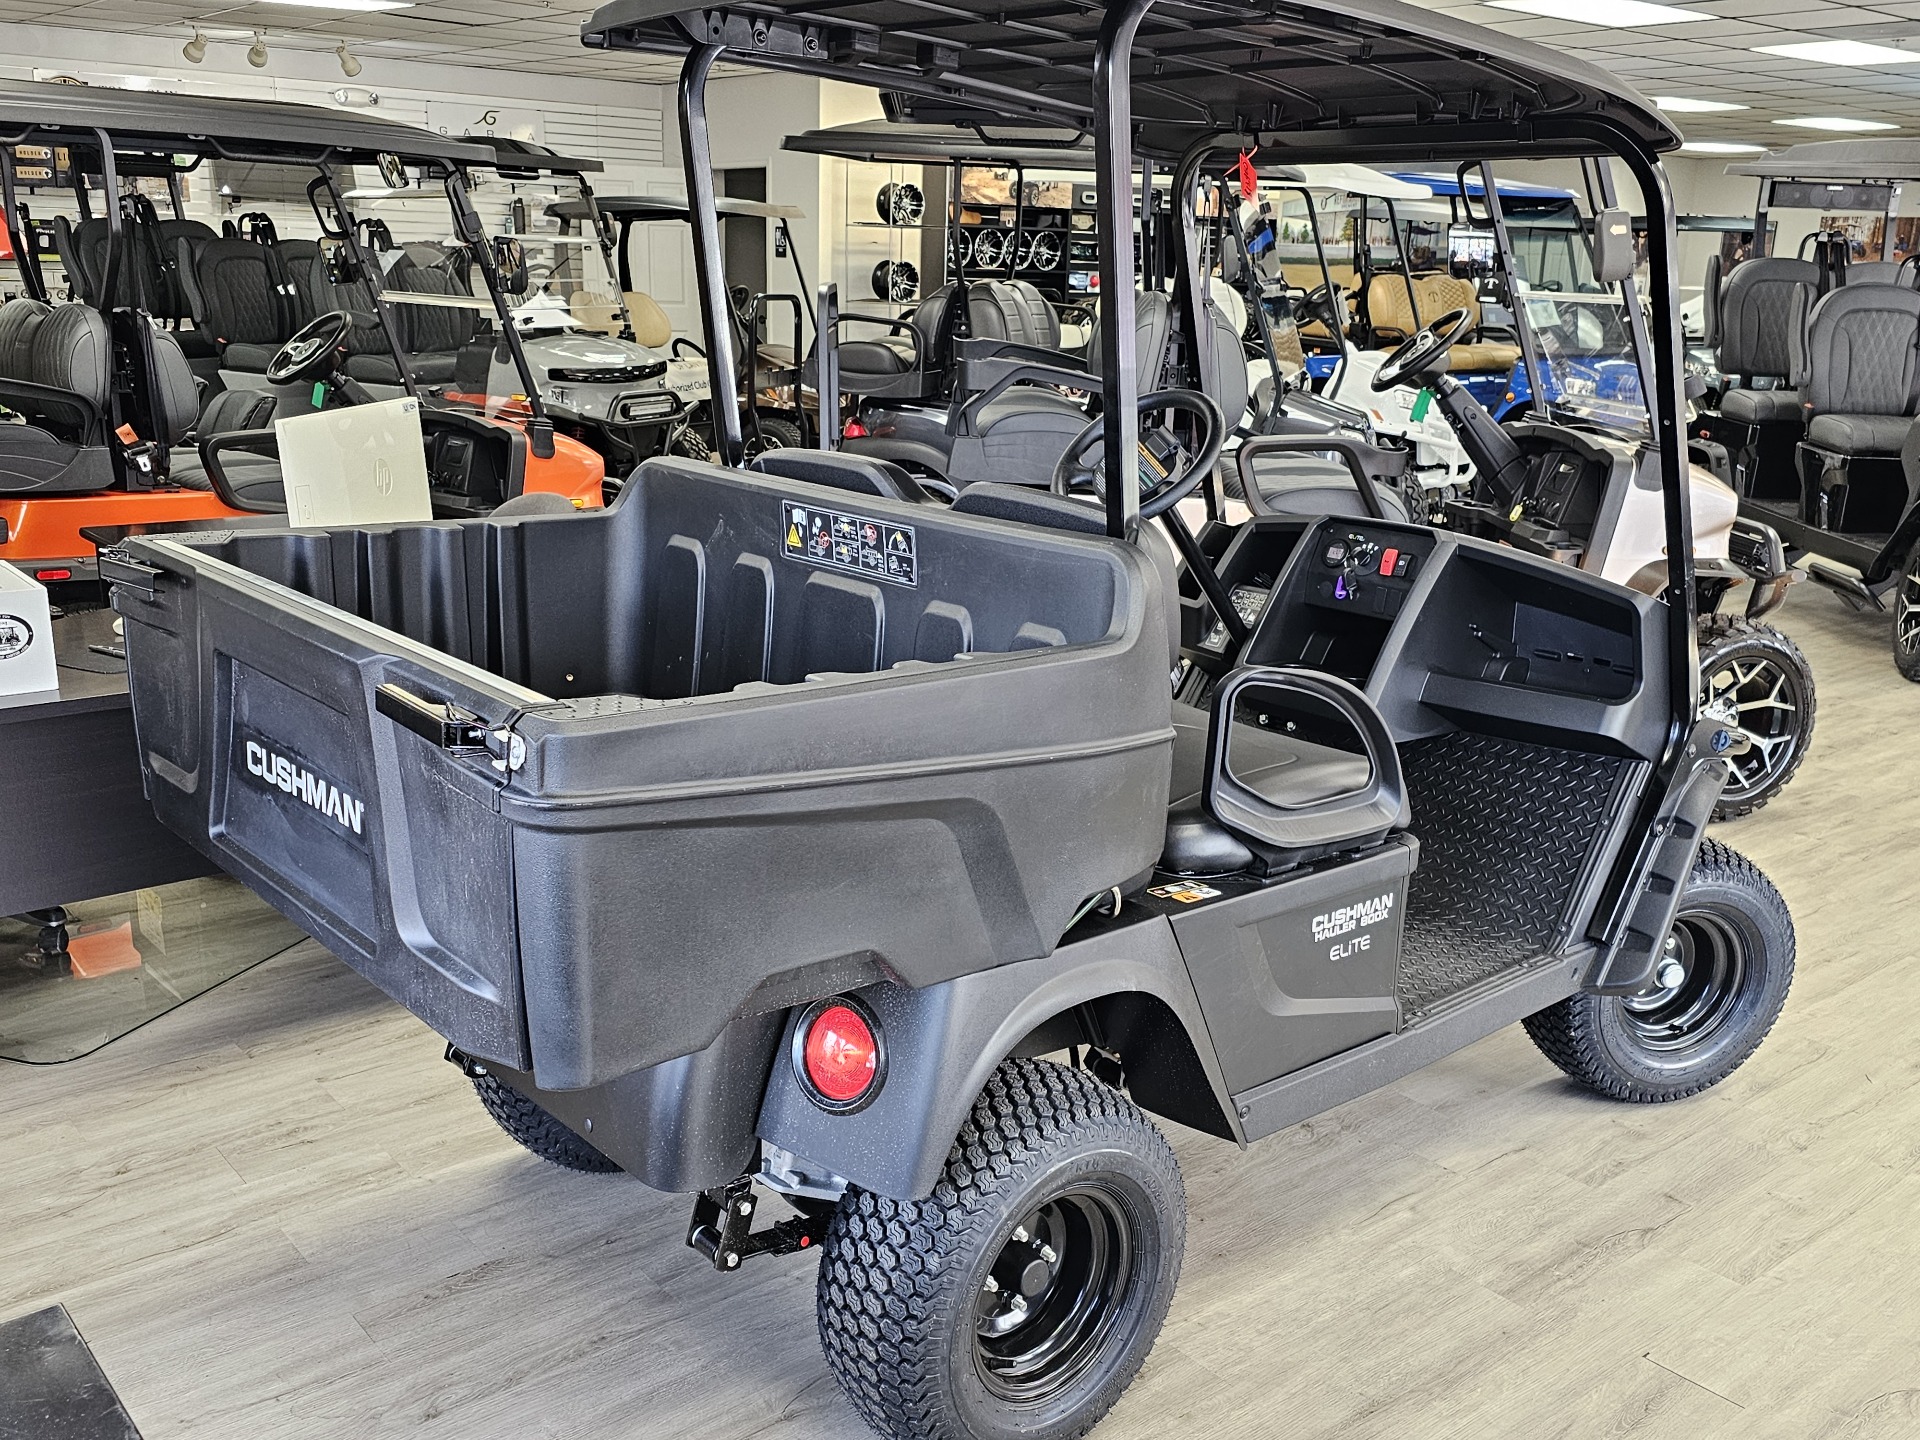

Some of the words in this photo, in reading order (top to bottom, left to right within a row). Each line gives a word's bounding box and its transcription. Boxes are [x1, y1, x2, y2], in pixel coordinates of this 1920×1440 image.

[246, 741, 362, 835] CUSHMAN
[1312, 892, 1393, 933] CUSHMAN
[1314, 919, 1357, 943] HAULER
[1360, 908, 1389, 927] 800X
